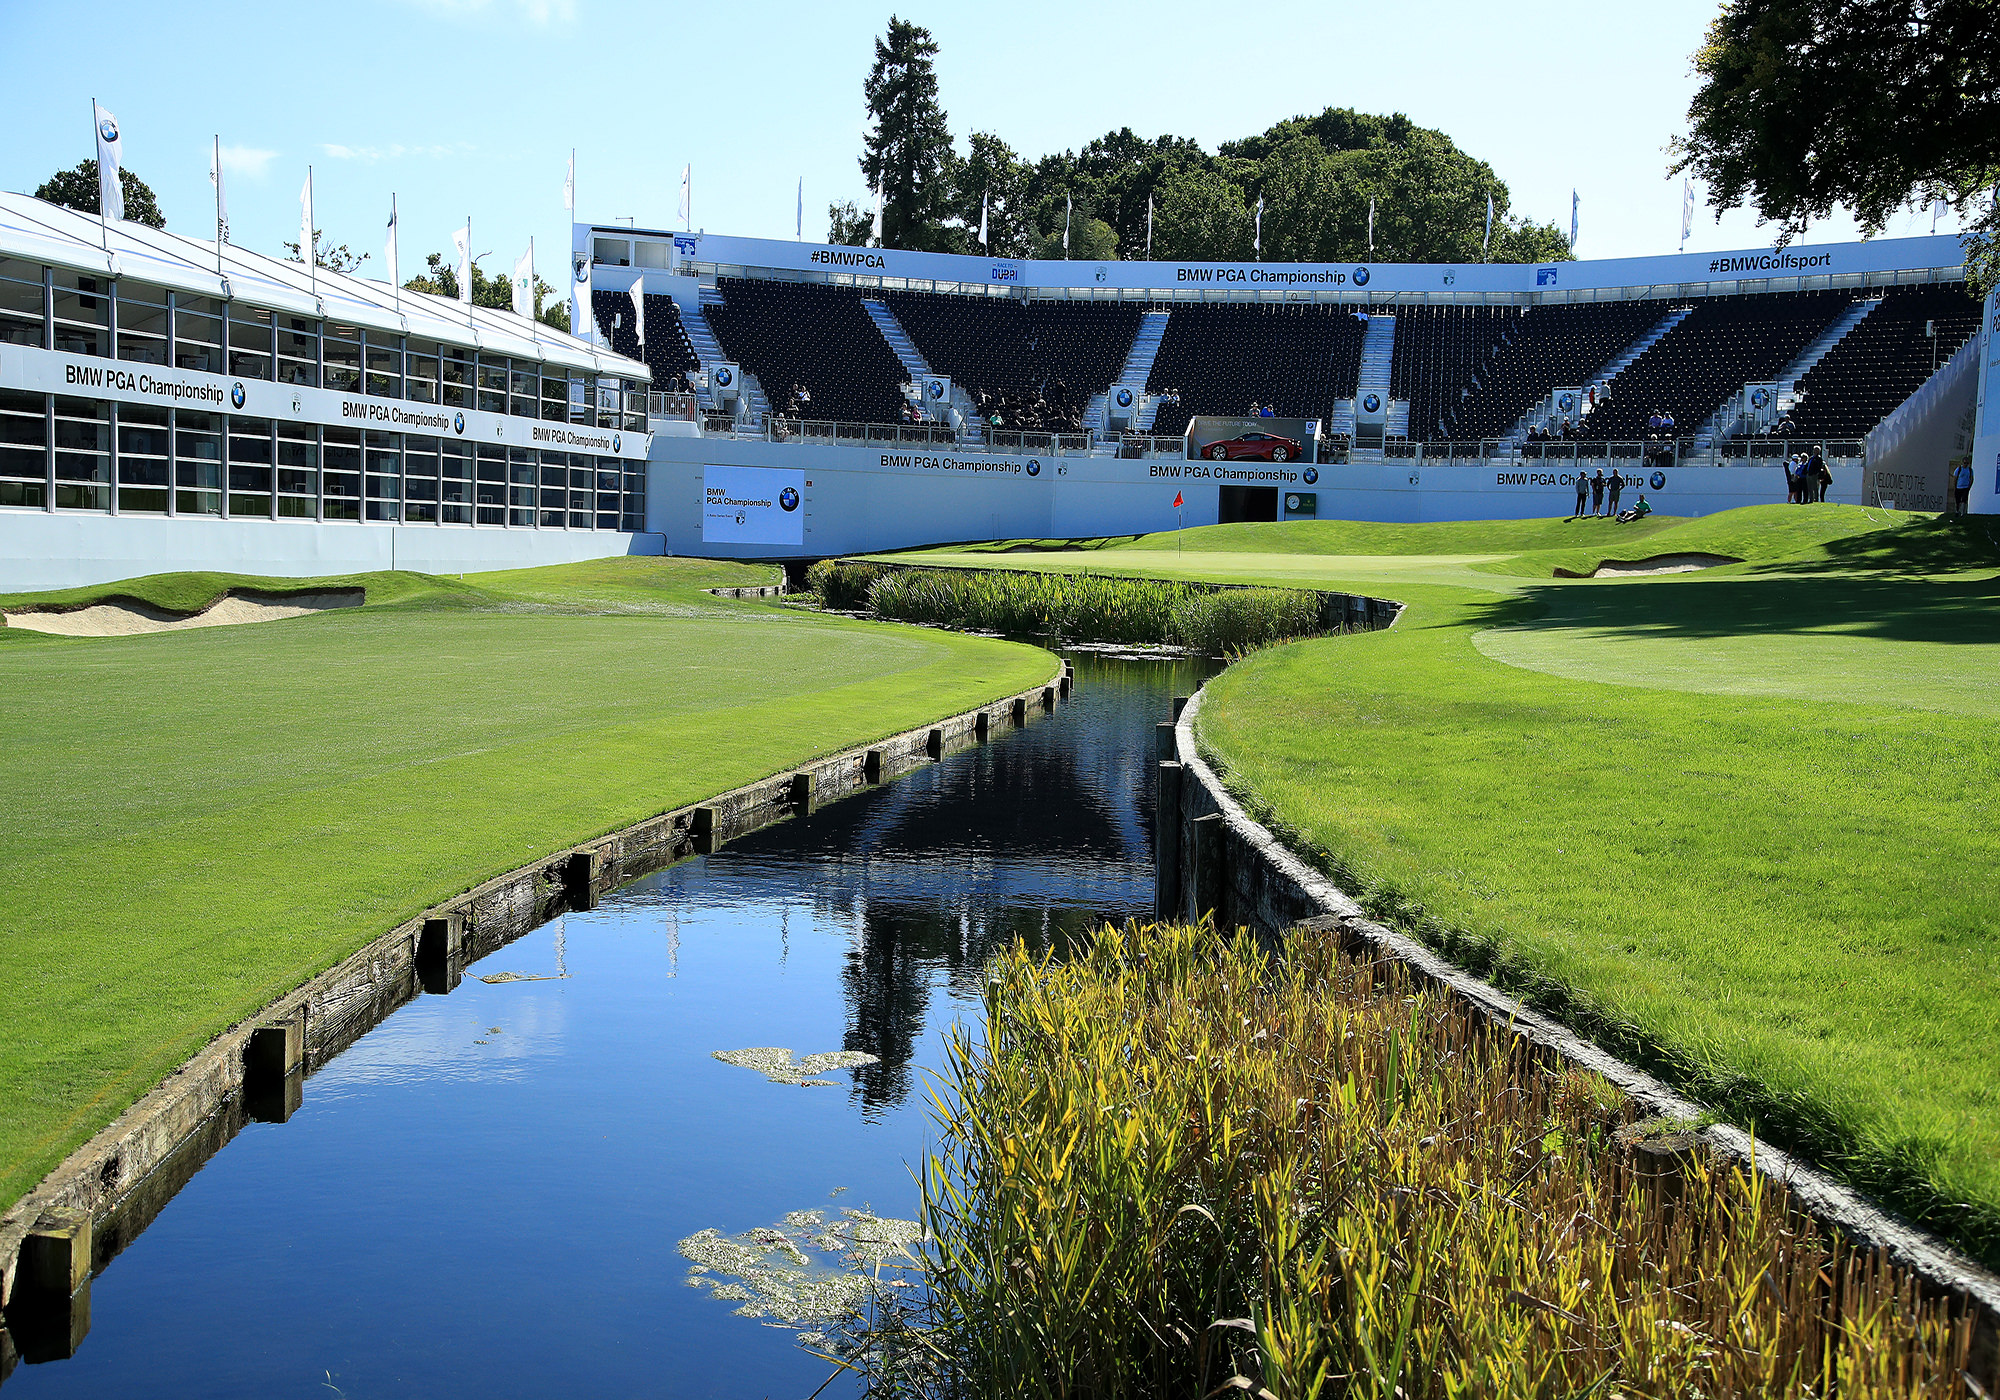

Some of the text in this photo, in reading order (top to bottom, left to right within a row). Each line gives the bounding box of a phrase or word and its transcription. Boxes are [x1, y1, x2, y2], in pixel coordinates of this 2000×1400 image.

[811, 251, 885, 269] #BMWPGA
[1709, 252, 1831, 273] #BMWGolfsport
[992, 268, 1018, 280] DUBAI
[1178, 269, 1213, 282] BMW
[1217, 269, 1246, 282] PGA
[1251, 269, 1346, 285] Championship
[66, 364, 102, 387] BMW
[106, 370, 136, 391] PGA
[139, 374, 224, 405] Championship
[342, 401, 367, 419] BMW
[369, 404, 389, 422] PGA
[391, 408, 449, 432] Championship
[533, 427, 550, 442] BMW
[552, 430, 566, 443] PGA
[567, 431, 610, 451] Championship
[881, 455, 911, 468] BMW
[914, 457, 939, 469] PGA
[942, 457, 1021, 474] Championship
[1150, 466, 1181, 477] BMW
[1184, 467, 1210, 478] PGA
[1213, 467, 1298, 483] Championship
[1497, 474, 1527, 485] BMW
[1530, 474, 1556, 485] PGA
[707, 488, 725, 496] BMW
[706, 497, 723, 505] PGA
[723, 497, 772, 508] Championship
